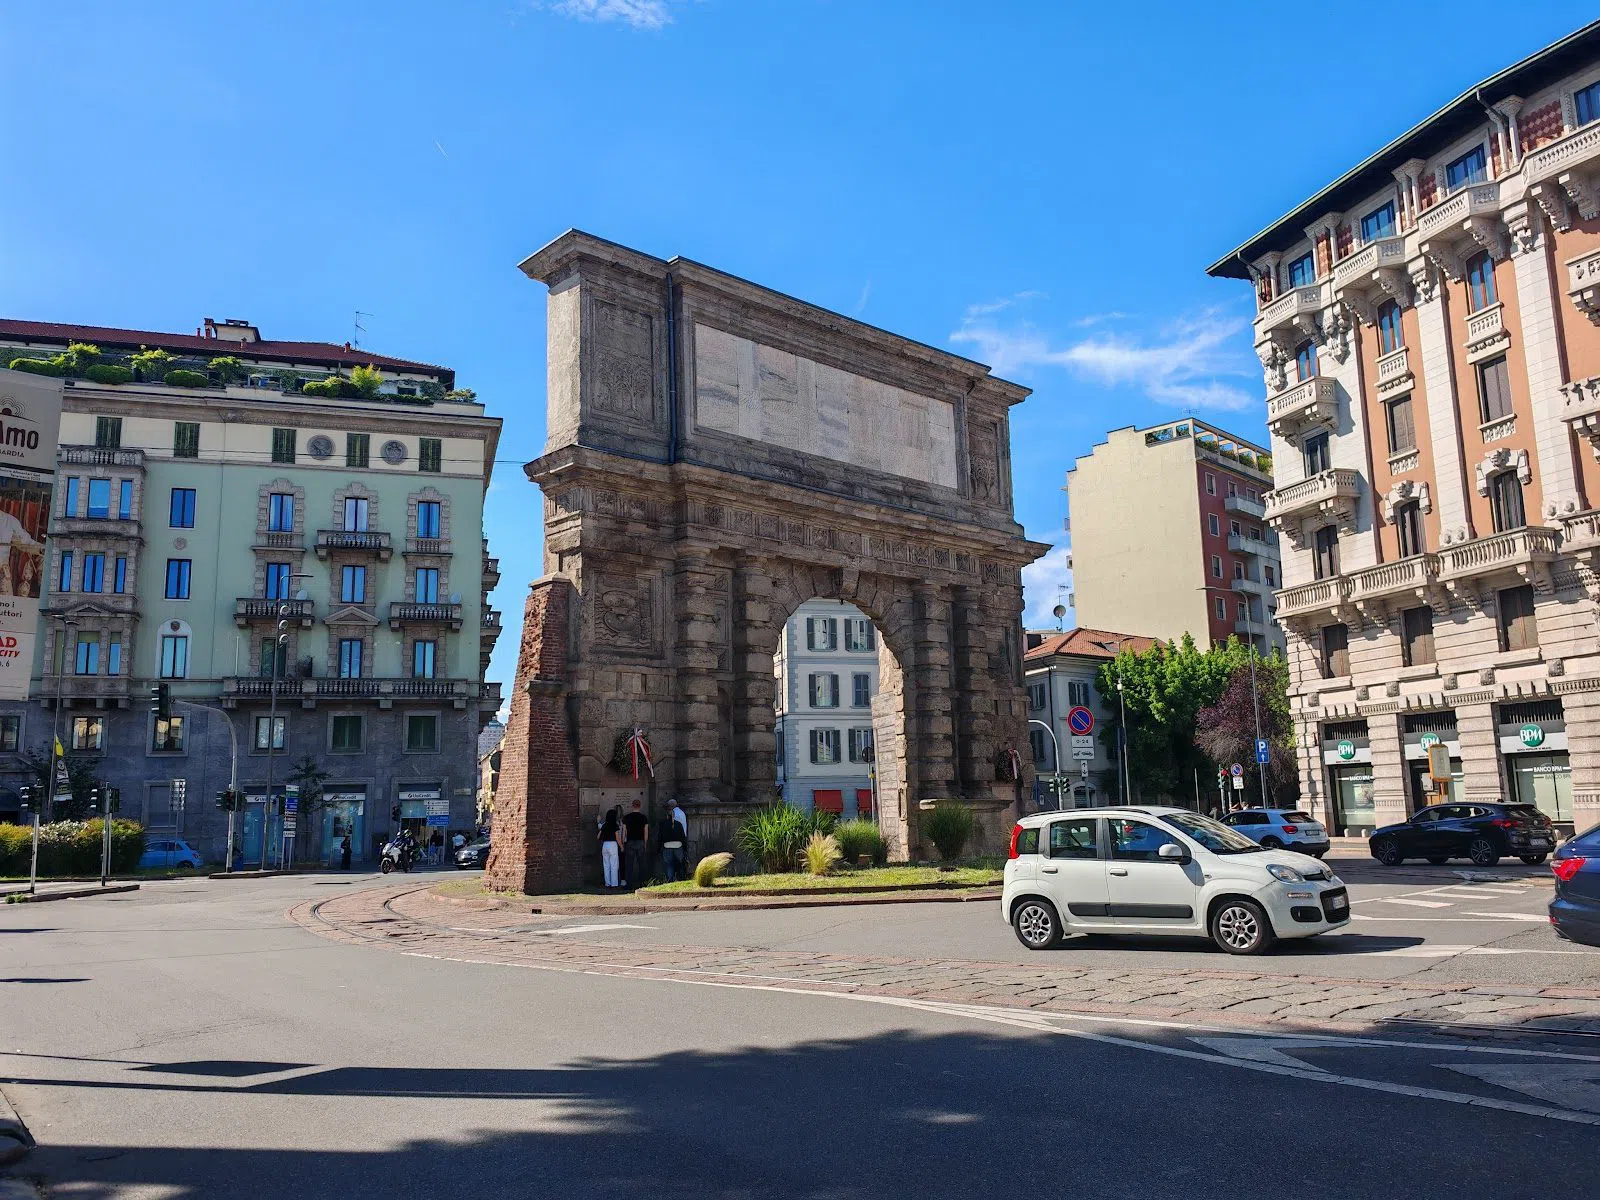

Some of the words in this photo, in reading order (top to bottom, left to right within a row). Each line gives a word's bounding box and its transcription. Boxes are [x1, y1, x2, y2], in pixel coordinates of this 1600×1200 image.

[0, 449, 25, 458] ARDIA
[1520, 728, 1543, 742] BPM
[1258, 741, 1266, 753] P
[1337, 744, 1354, 755] BPM
